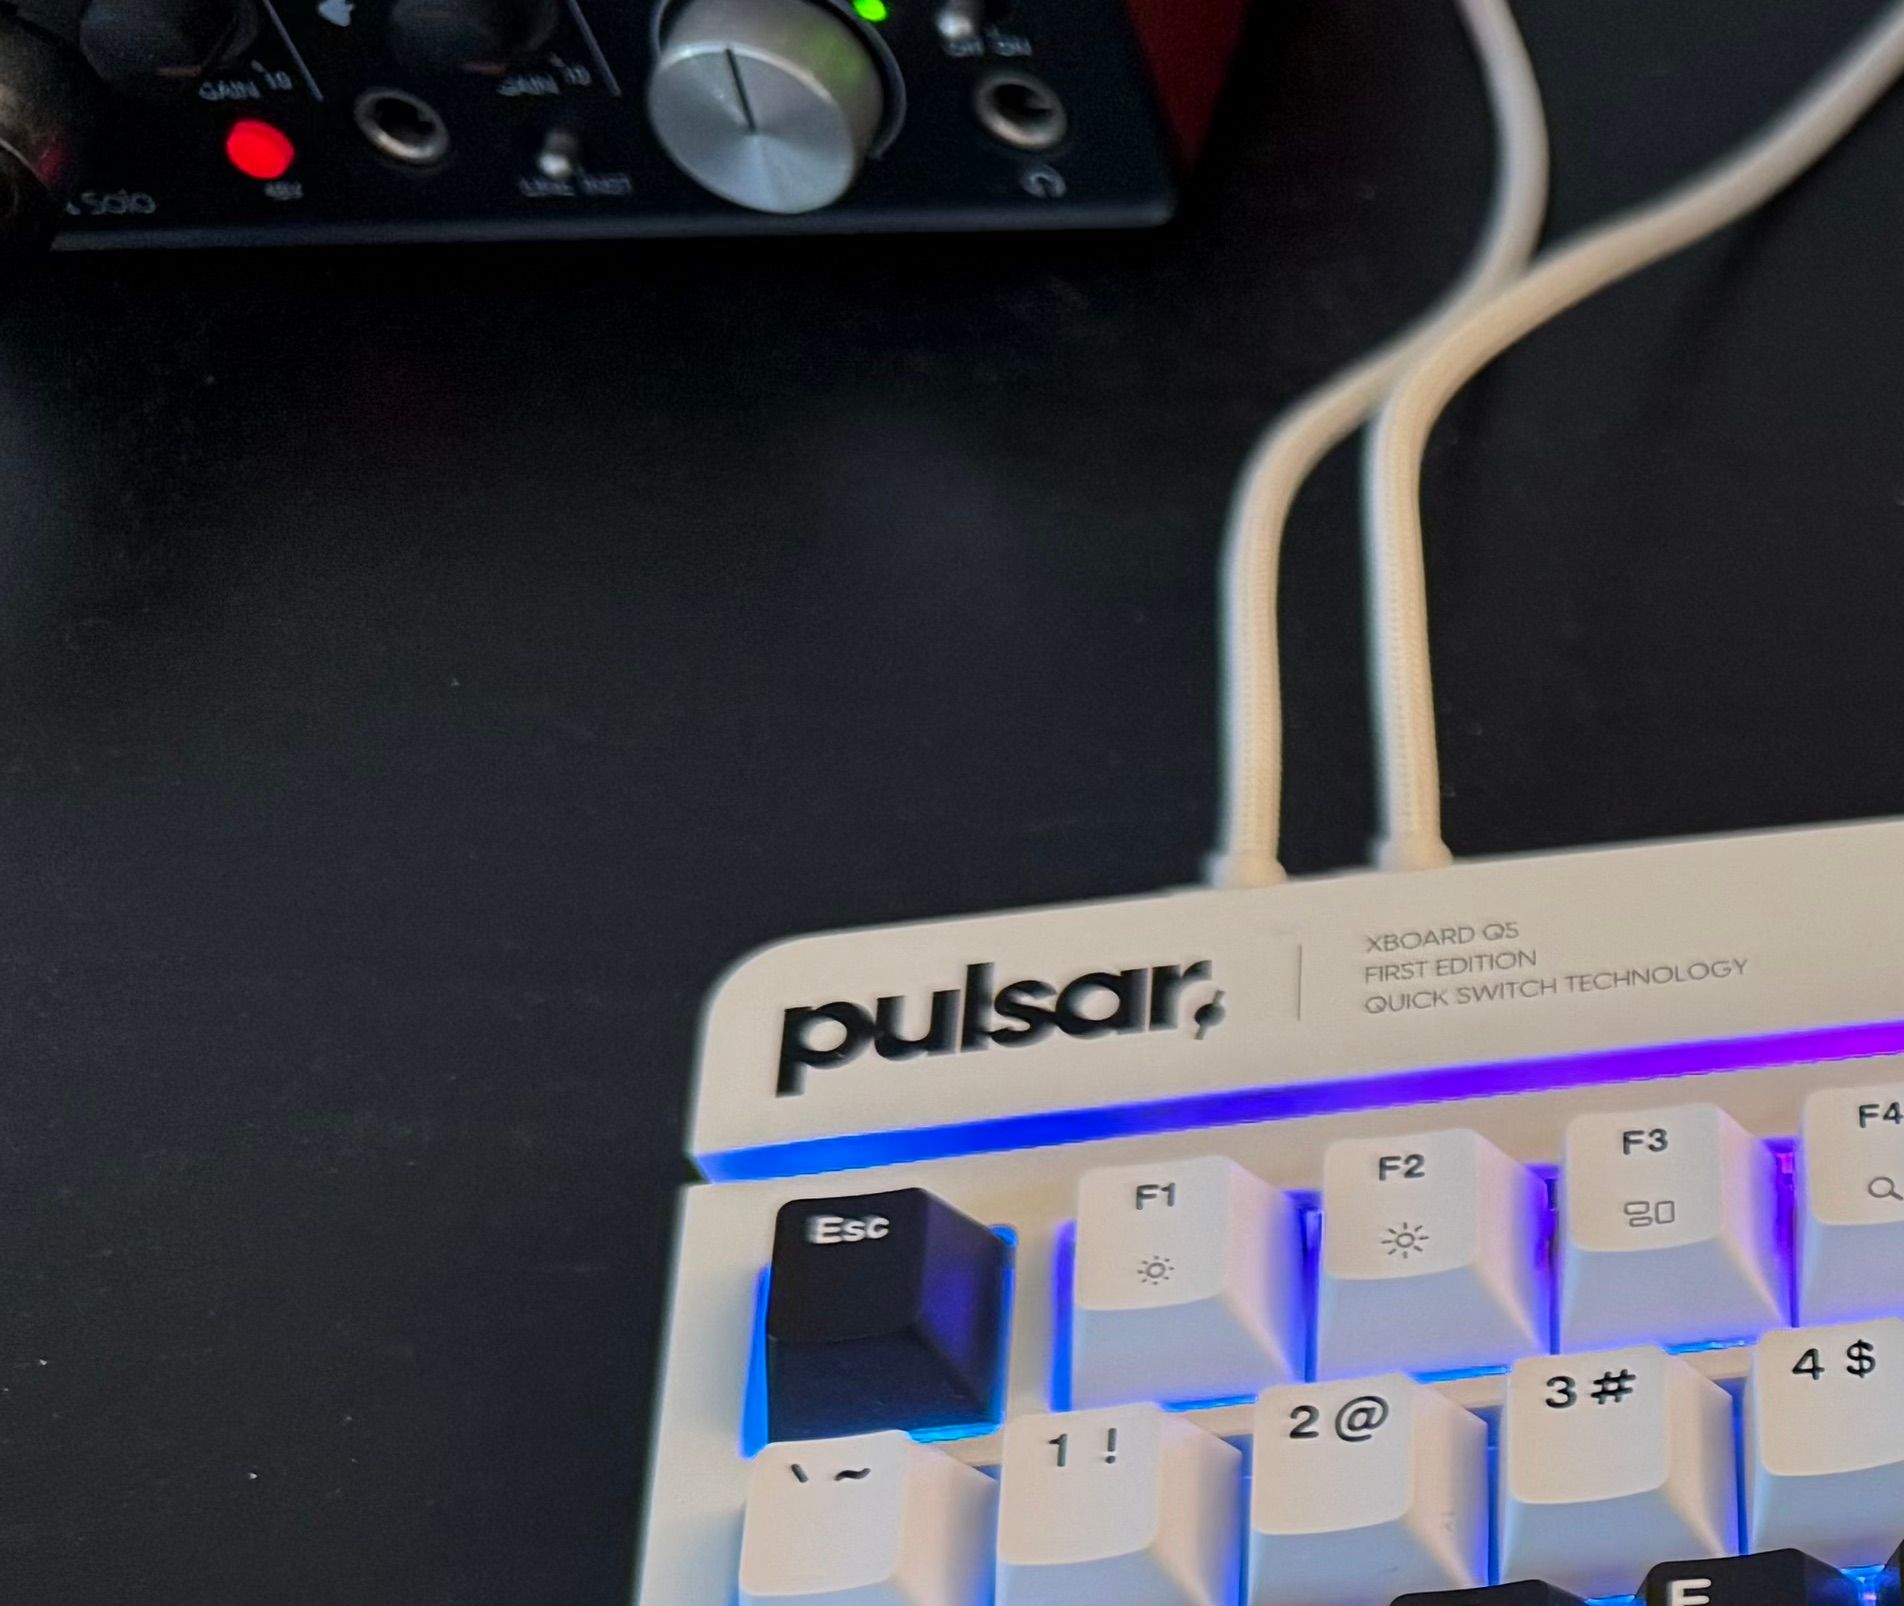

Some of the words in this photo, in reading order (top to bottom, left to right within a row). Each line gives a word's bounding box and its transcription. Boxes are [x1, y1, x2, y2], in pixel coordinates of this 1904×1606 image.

[1365, 925, 1476, 953] XBOARD
[1480, 921, 1520, 942] Q5
[1363, 959, 1429, 984] FIRST
[1434, 949, 1537, 977] EDITION
[1362, 989, 1449, 1015] QUICK
[1455, 977, 1558, 1005] SWITCH
[1563, 957, 1748, 993] TECHNOLOGY
[1857, 1101, 1904, 1129] F4
[1621, 1127, 1668, 1156] F3
[1377, 1153, 1425, 1181] F2
[1134, 1182, 1176, 1210] F1
[809, 1215, 890, 1244] Esc
